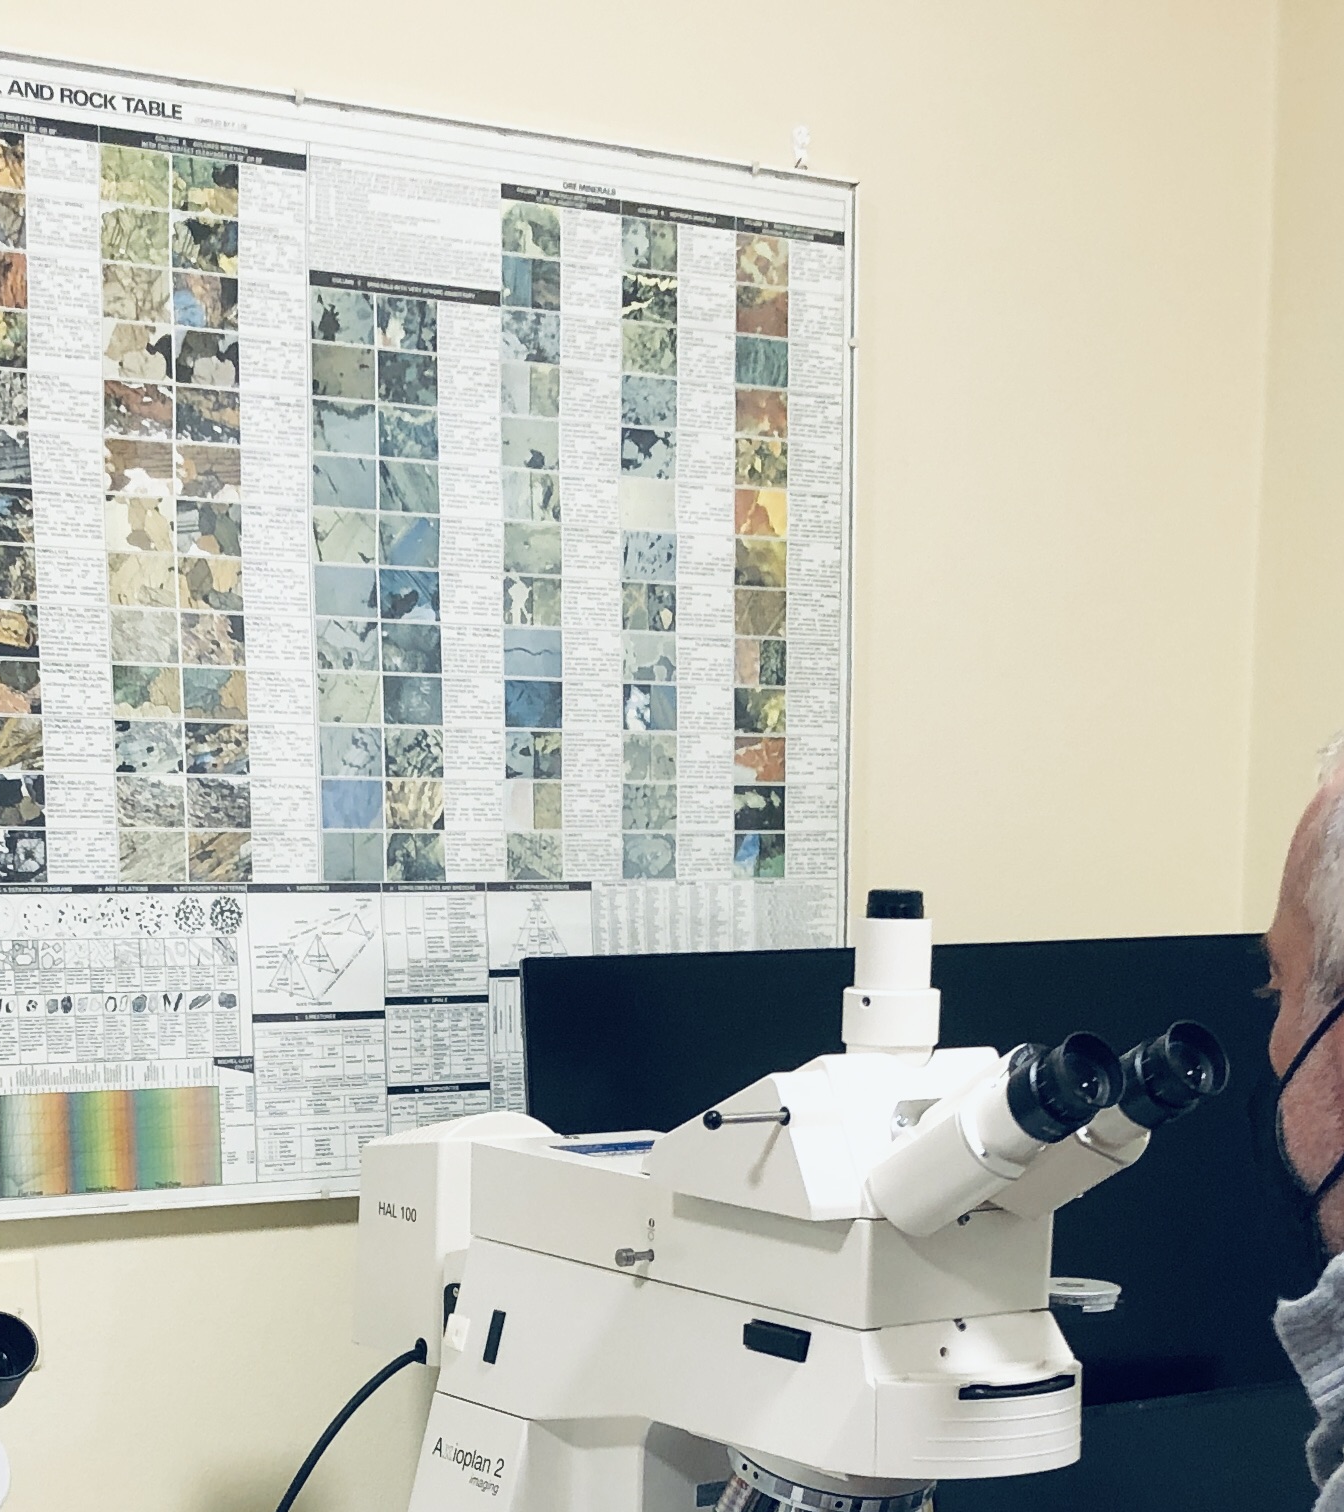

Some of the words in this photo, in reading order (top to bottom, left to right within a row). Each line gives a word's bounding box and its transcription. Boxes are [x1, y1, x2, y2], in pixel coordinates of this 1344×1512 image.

[8, 80, 54, 101] AND
[60, 87, 117, 112] ROCK
[122, 96, 183, 121] TABLE
[378, 1201, 397, 1219] HAL
[400, 1206, 417, 1223] 100
[494, 1458, 505, 1478] 2
